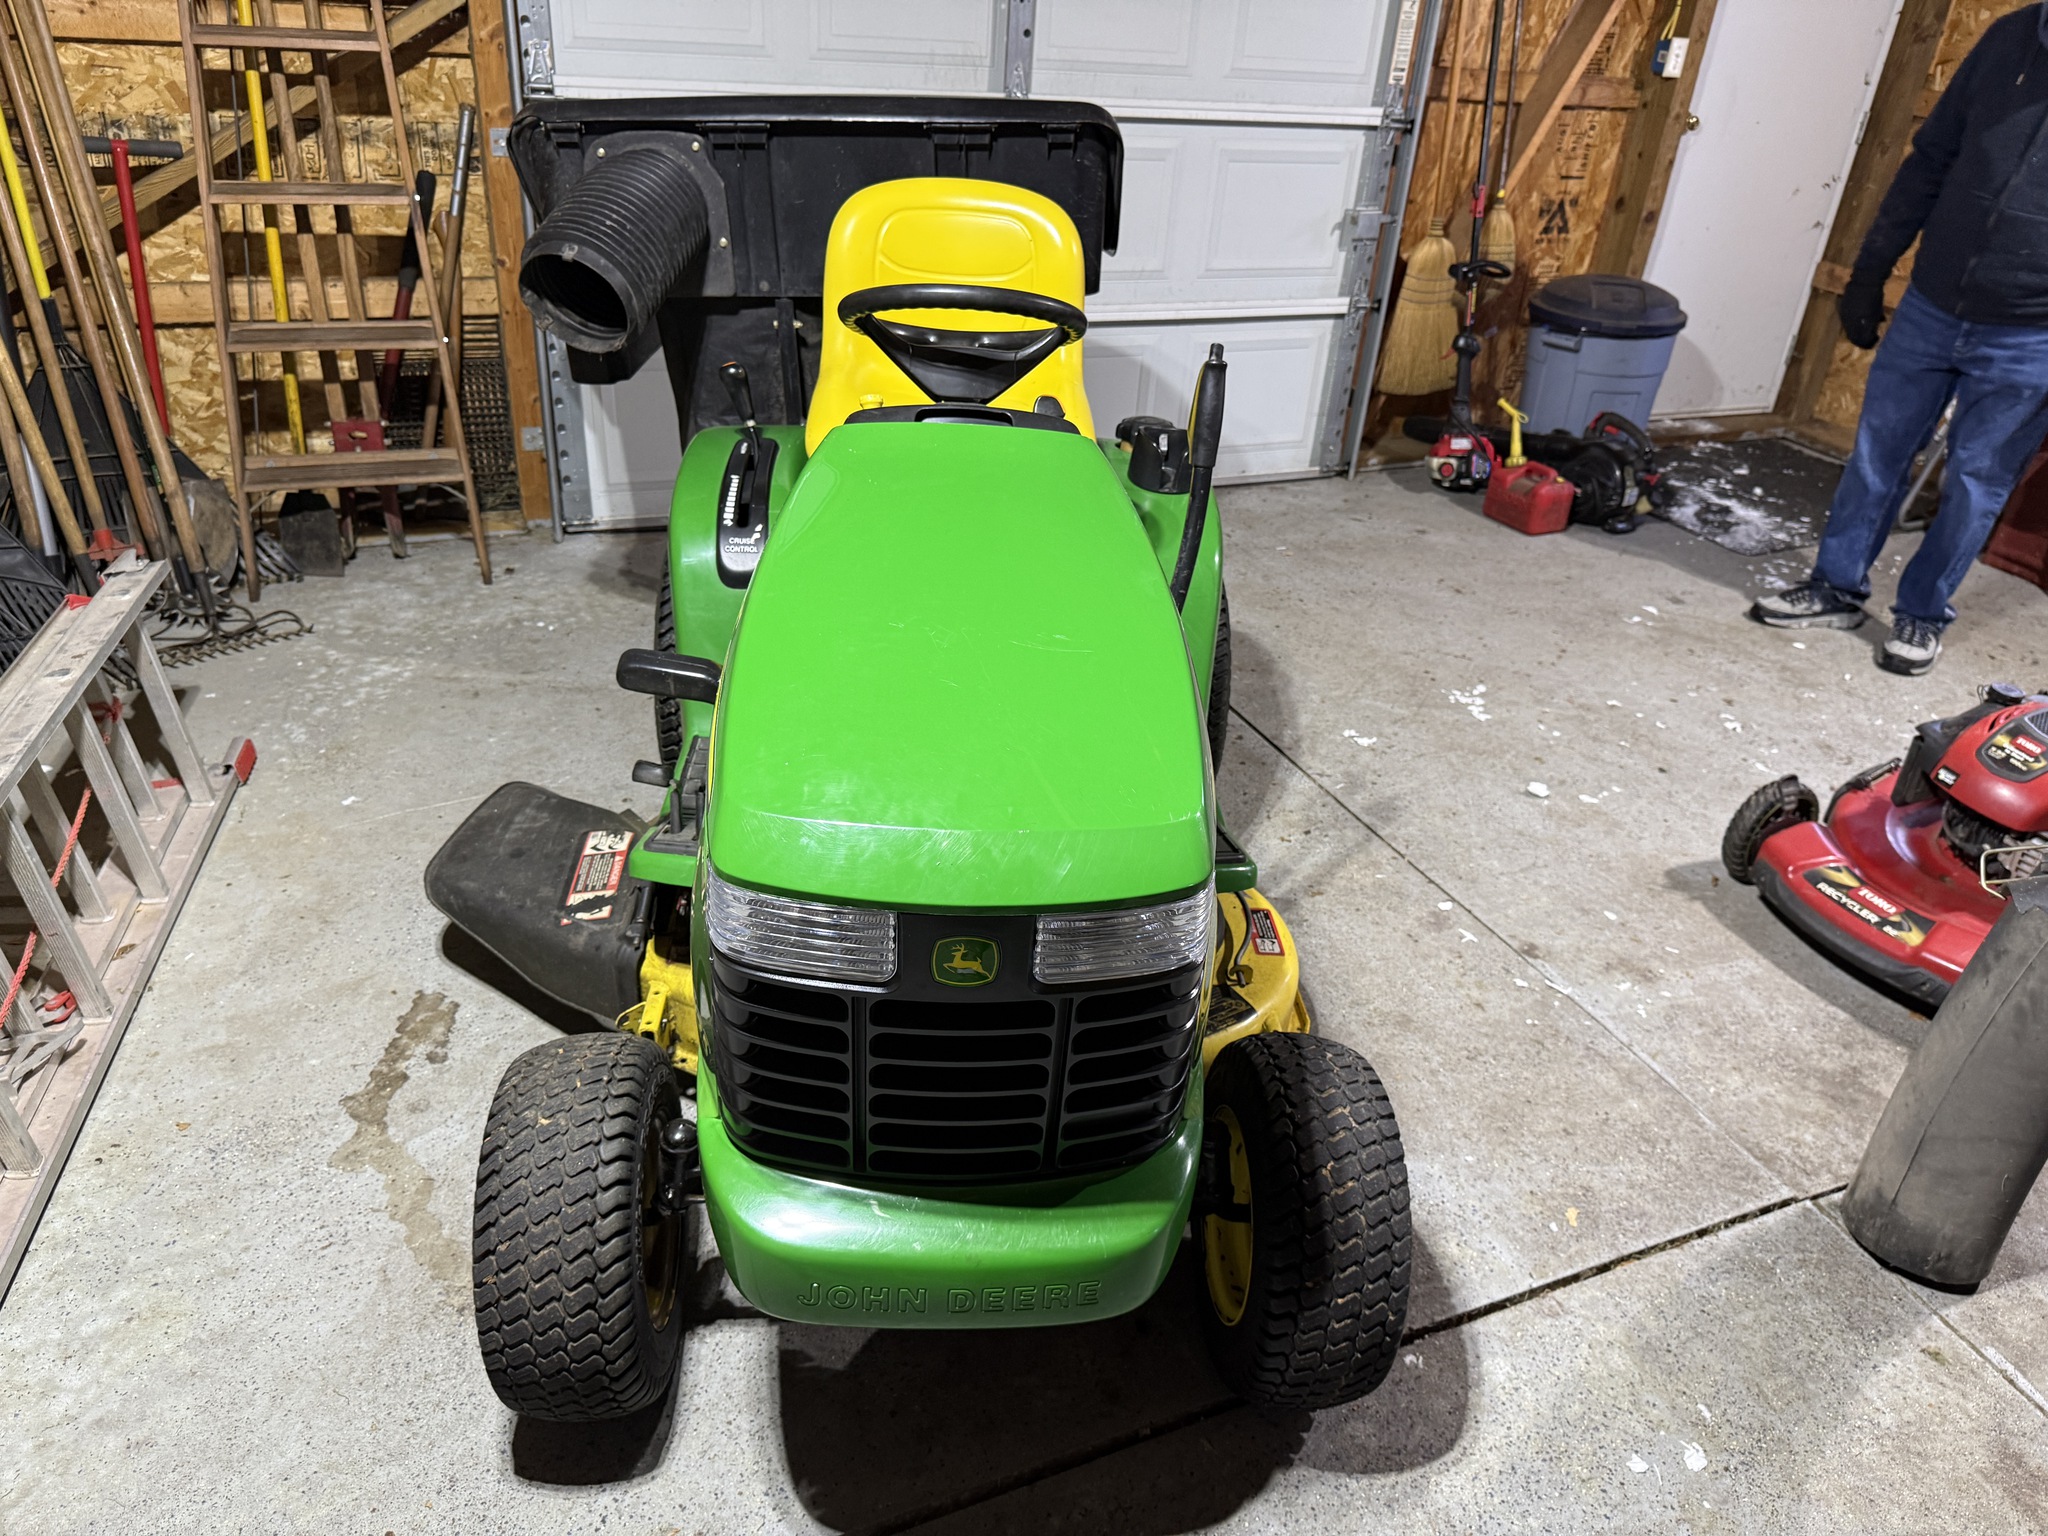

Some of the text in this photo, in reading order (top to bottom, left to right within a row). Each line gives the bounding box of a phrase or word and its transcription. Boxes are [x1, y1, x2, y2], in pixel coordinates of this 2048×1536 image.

[724, 545, 758, 553] CONTROL
[728, 537, 755, 545] CRUISE
[1815, 882, 1882, 924] RECYCLER
[1857, 888, 1898, 914] TORO
[796, 1280, 1102, 1314] JOHN DEERE
